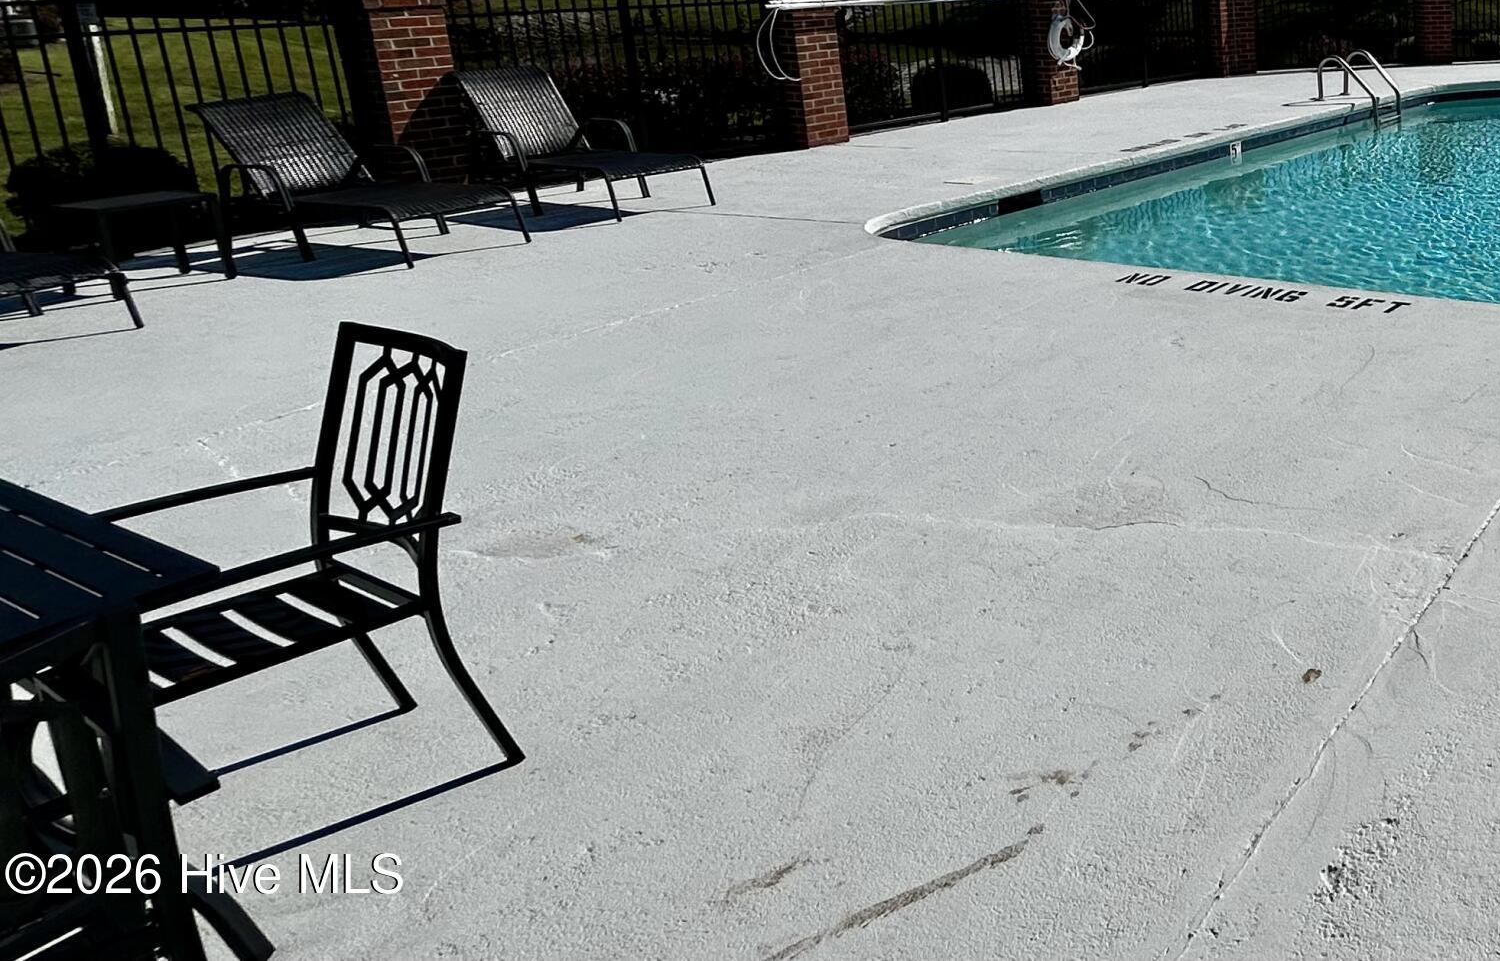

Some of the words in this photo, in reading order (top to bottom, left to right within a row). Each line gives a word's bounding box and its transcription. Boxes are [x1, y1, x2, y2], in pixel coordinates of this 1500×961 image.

[1115, 273, 1172, 286] NO
[1184, 280, 1309, 303] DIVING
[1326, 295, 1411, 314] 5FT
